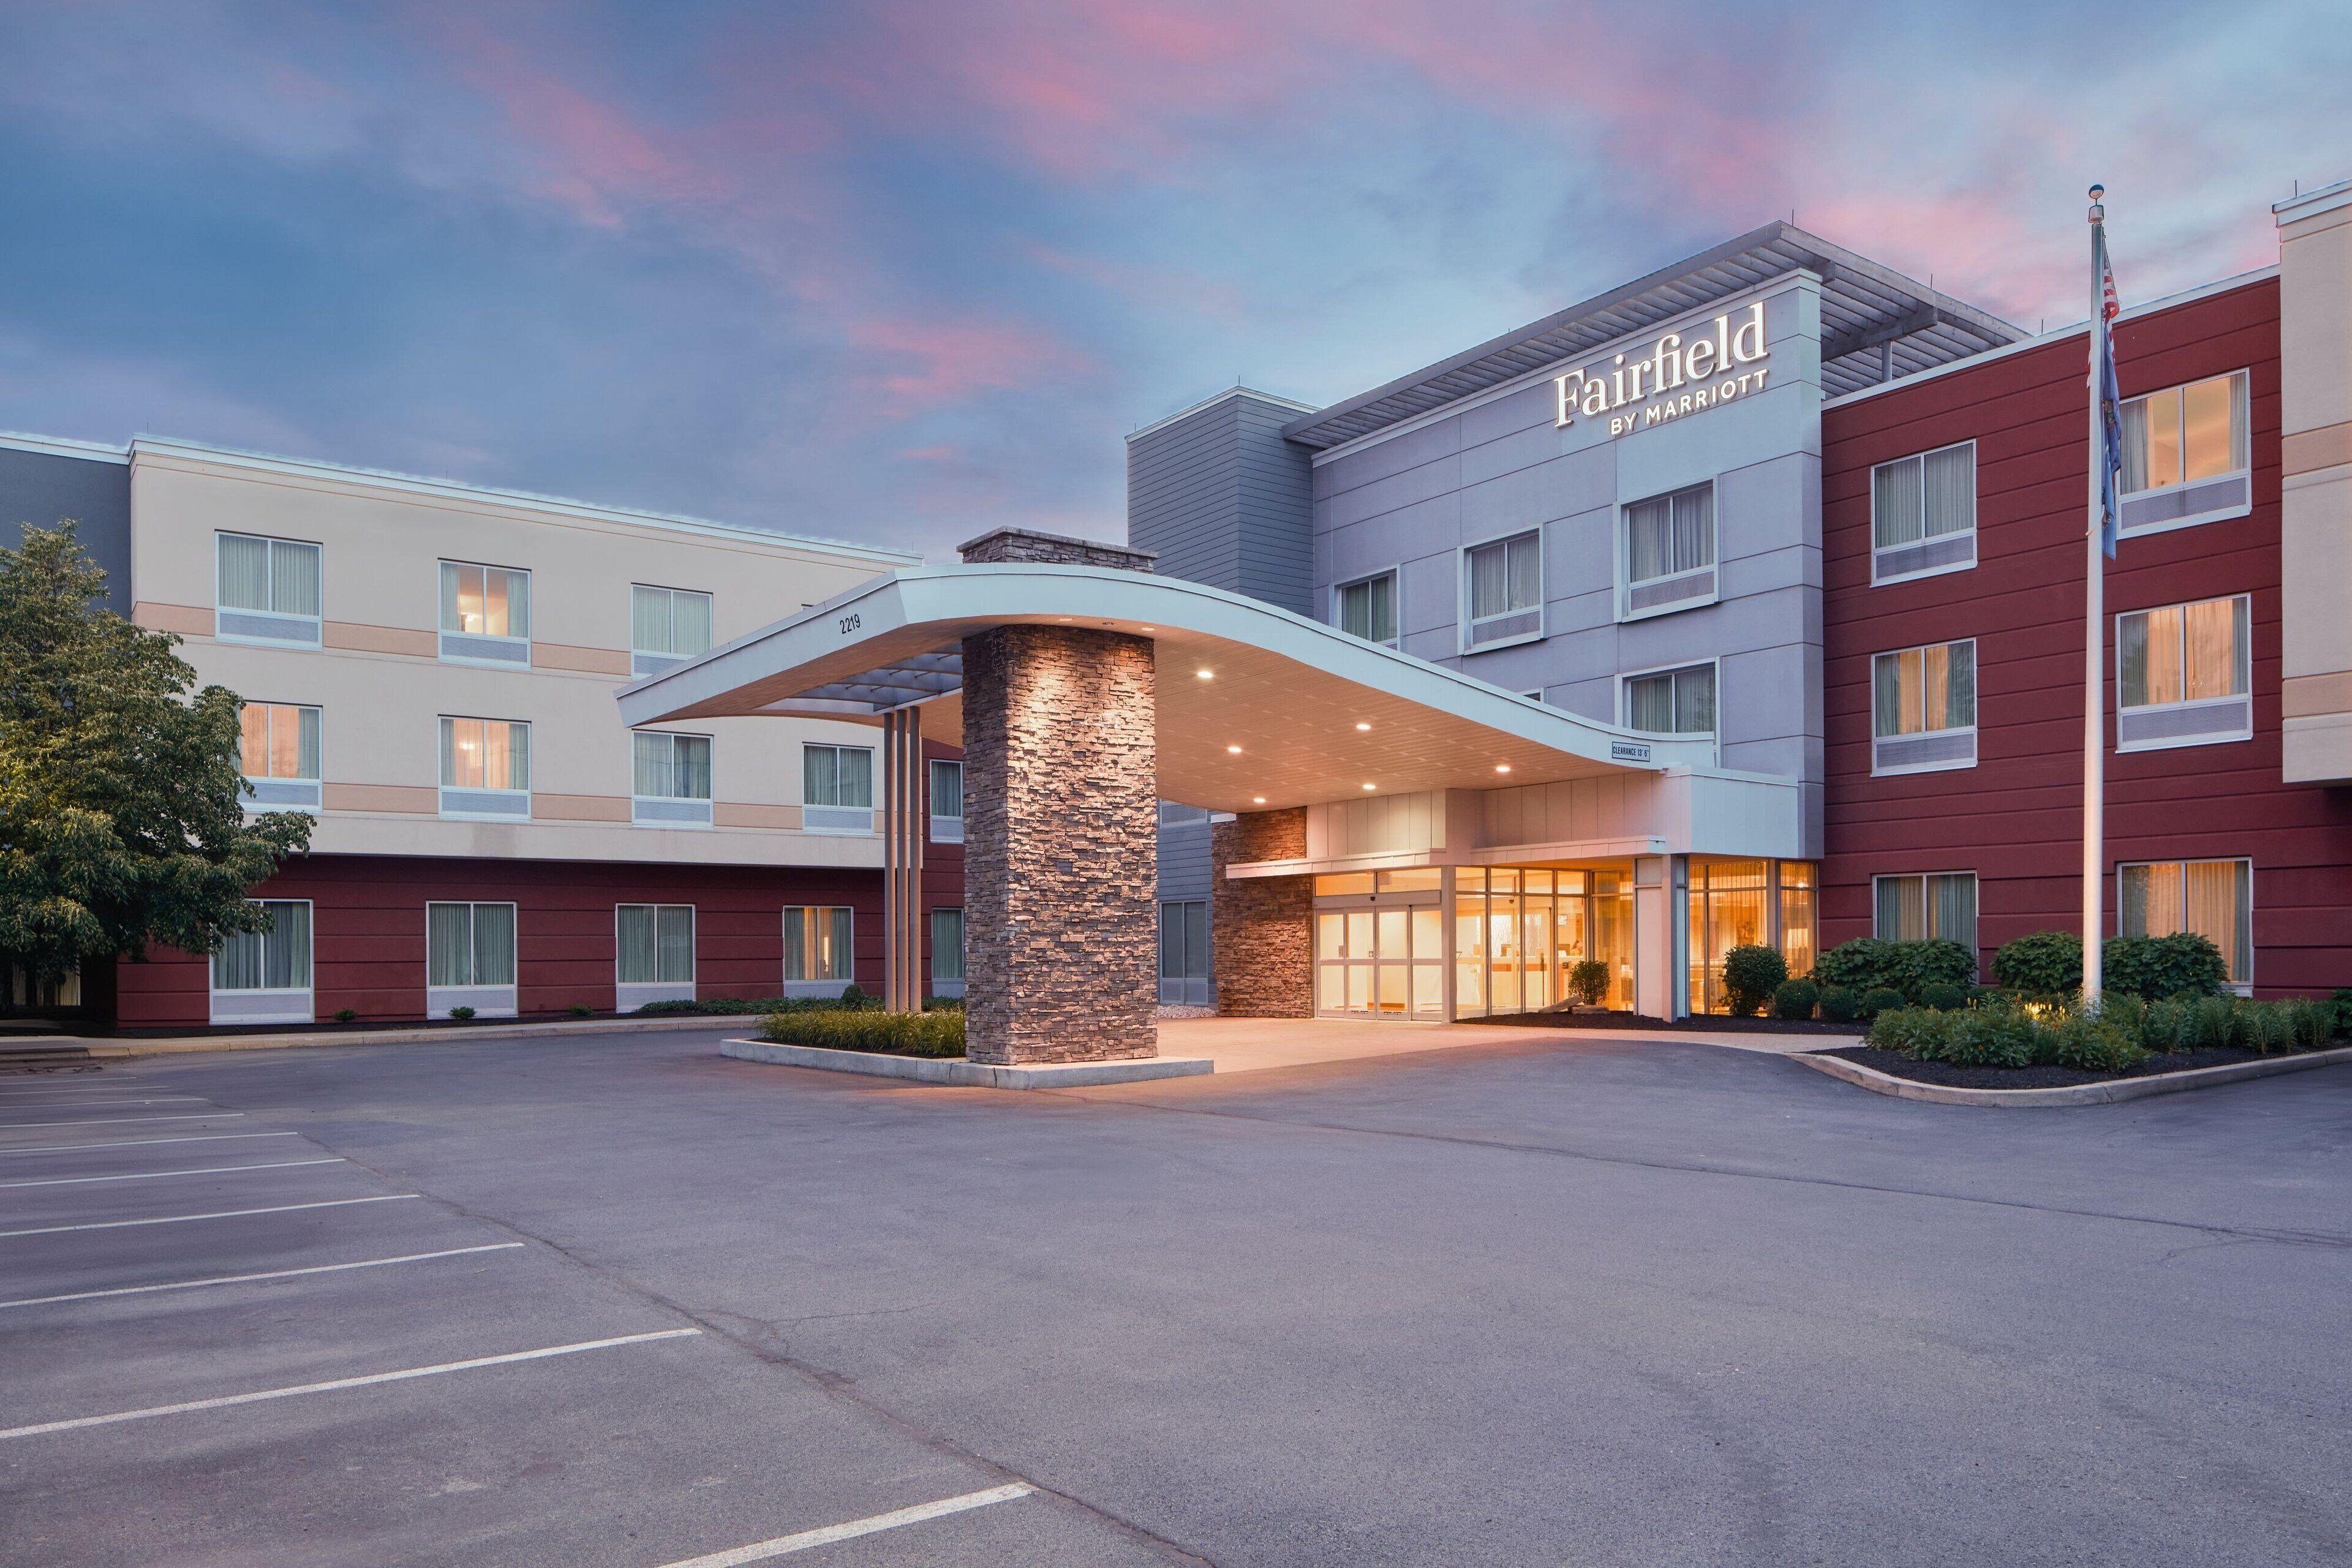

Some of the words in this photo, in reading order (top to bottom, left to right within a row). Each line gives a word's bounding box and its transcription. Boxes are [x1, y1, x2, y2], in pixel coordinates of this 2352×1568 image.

[1554, 301, 1770, 428] Fairfield
[1610, 412, 1639, 436] BY
[1646, 369, 1770, 425] MARRIOTT
[840, 614, 861, 634] 2219
[1613, 746, 1637, 756] CLEARANCE
